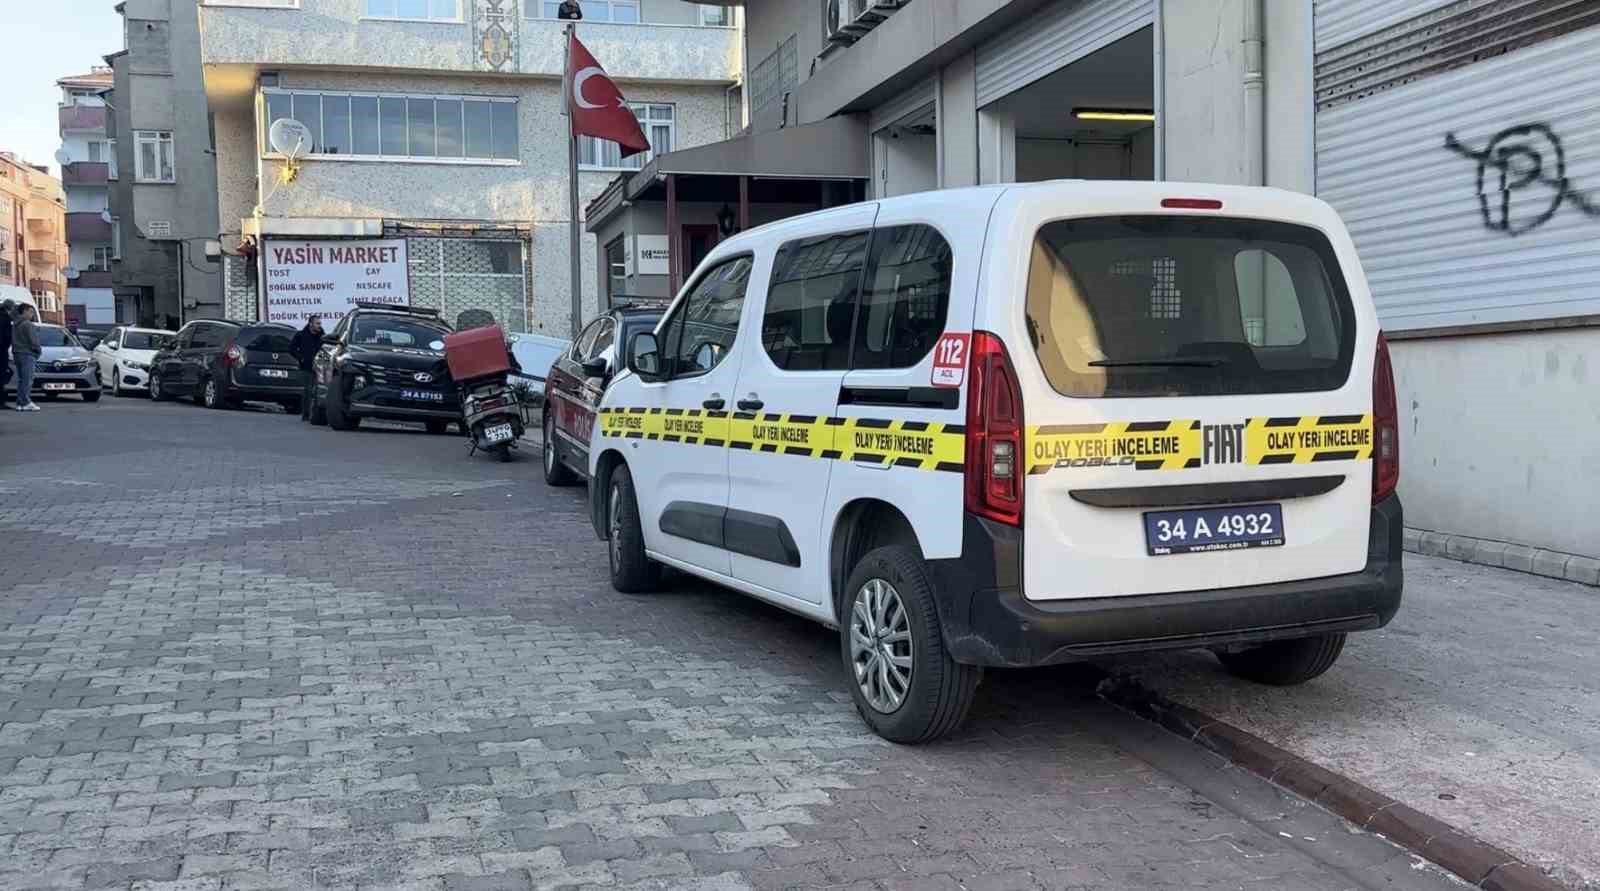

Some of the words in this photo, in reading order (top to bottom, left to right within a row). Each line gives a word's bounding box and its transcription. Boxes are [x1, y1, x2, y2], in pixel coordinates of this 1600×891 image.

[273, 243, 323, 265] YASİN
[330, 246, 398, 264] MARKET
[269, 269, 291, 277] TOST
[365, 267, 381, 276] ÇAY
[356, 281, 392, 290] NESCAFE
[269, 297, 322, 306] KAHVALTILIK
[940, 339, 964, 364] 112
[855, 432, 874, 448] OLAY
[1203, 424, 1245, 464] FIAT
[1267, 432, 1295, 449] OLAY
[1034, 440, 1071, 459] OLAY
[1054, 456, 1136, 469] DOBLO
[1157, 518, 1187, 542] 34
[1193, 517, 1212, 539] A
[1217, 513, 1273, 536] 4932
